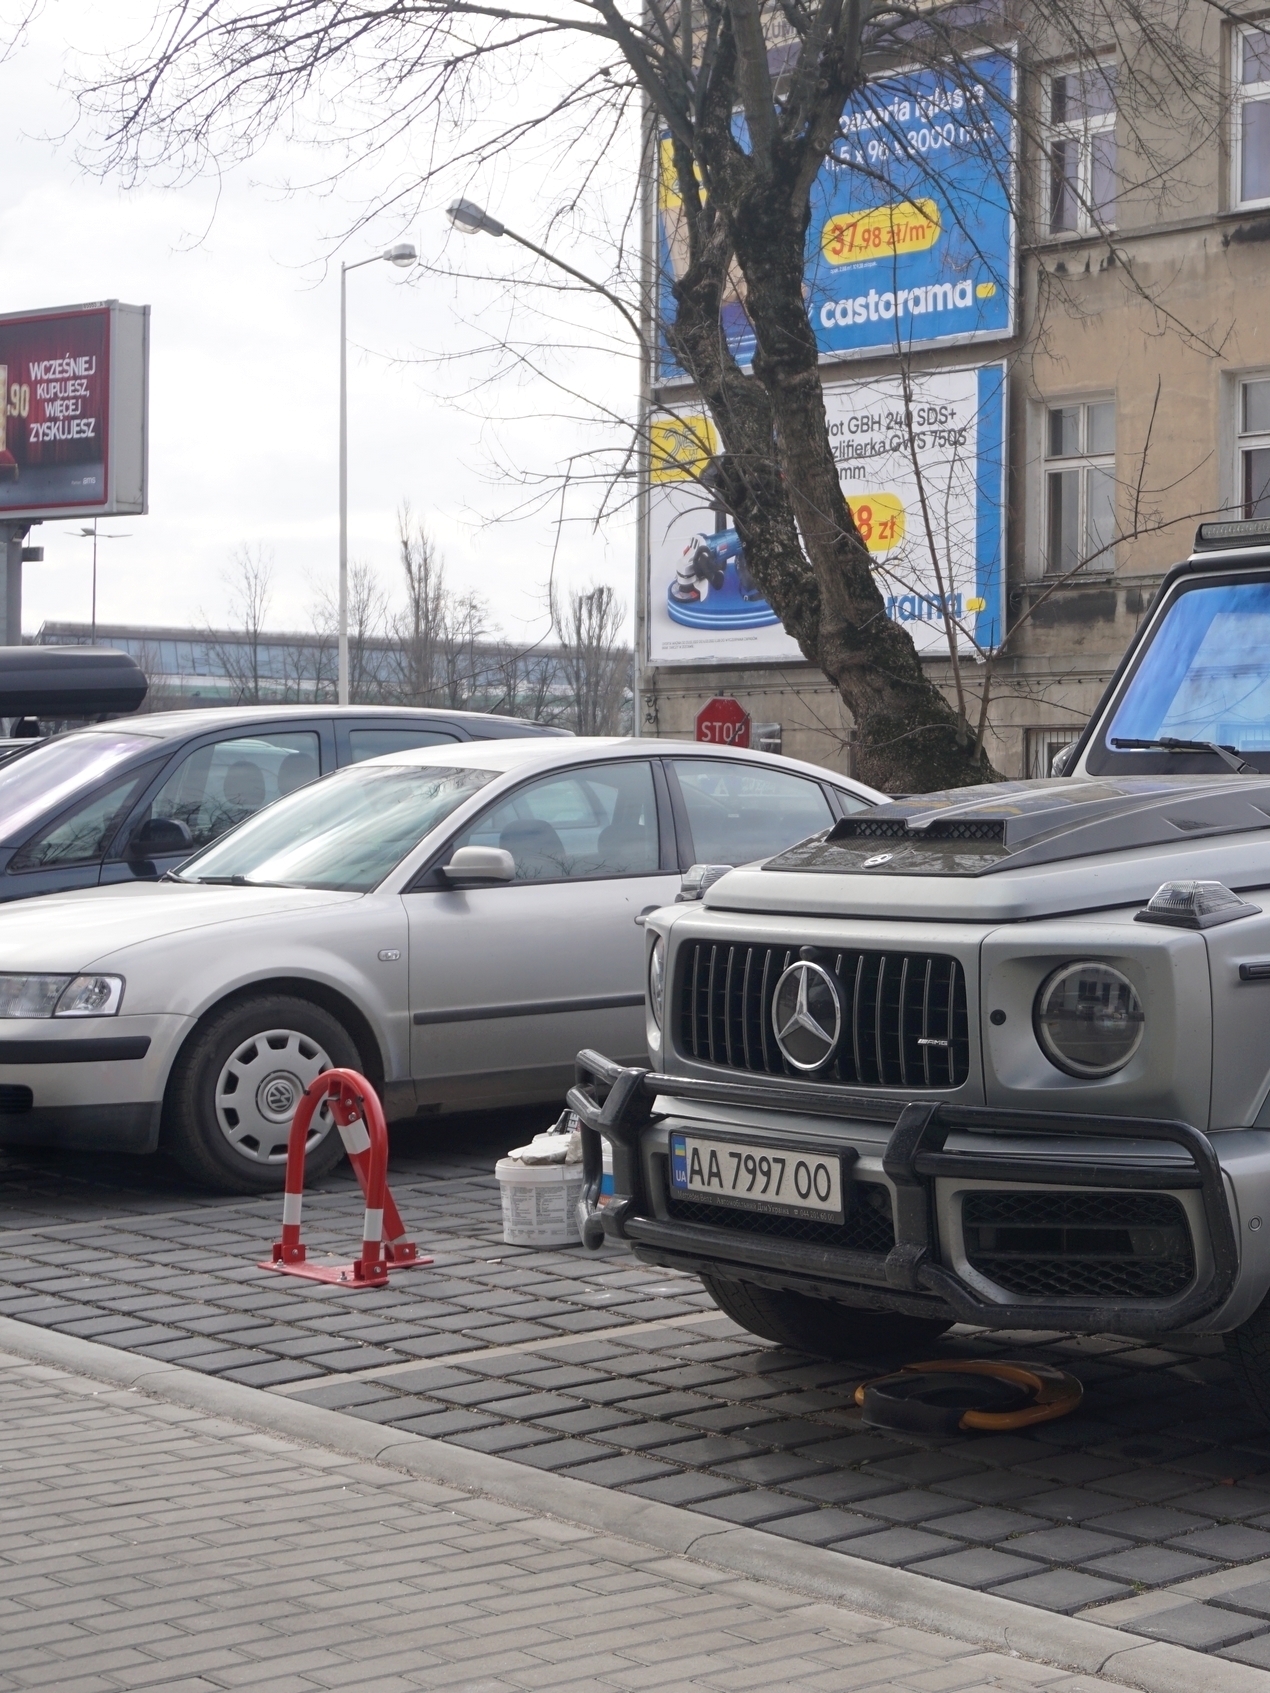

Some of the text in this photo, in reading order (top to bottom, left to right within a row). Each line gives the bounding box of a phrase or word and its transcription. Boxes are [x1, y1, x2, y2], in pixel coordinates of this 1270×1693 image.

[868, 139, 889, 163] 96
[907, 123, 955, 155] 3000
[829, 221, 882, 255] 37,98
[820, 279, 973, 328] castorama
[30, 352, 96, 381] WCZEŚNIEJ
[37, 379, 90, 400] KUPUJESZ,
[45, 399, 81, 420] WIĘCEJ
[848, 413, 881, 434] GBH
[885, 409, 913, 431] 240
[917, 405, 957, 427] SDS+
[30, 418, 95, 443] ZYSKUJESZ
[889, 432, 926, 453] GWS
[878, 514, 896, 540] zł
[701, 721, 745, 743] STOP
[675, 1169, 687, 1183] UA
[689, 1147, 723, 1188] AA
[728, 1151, 786, 1196] 7997
